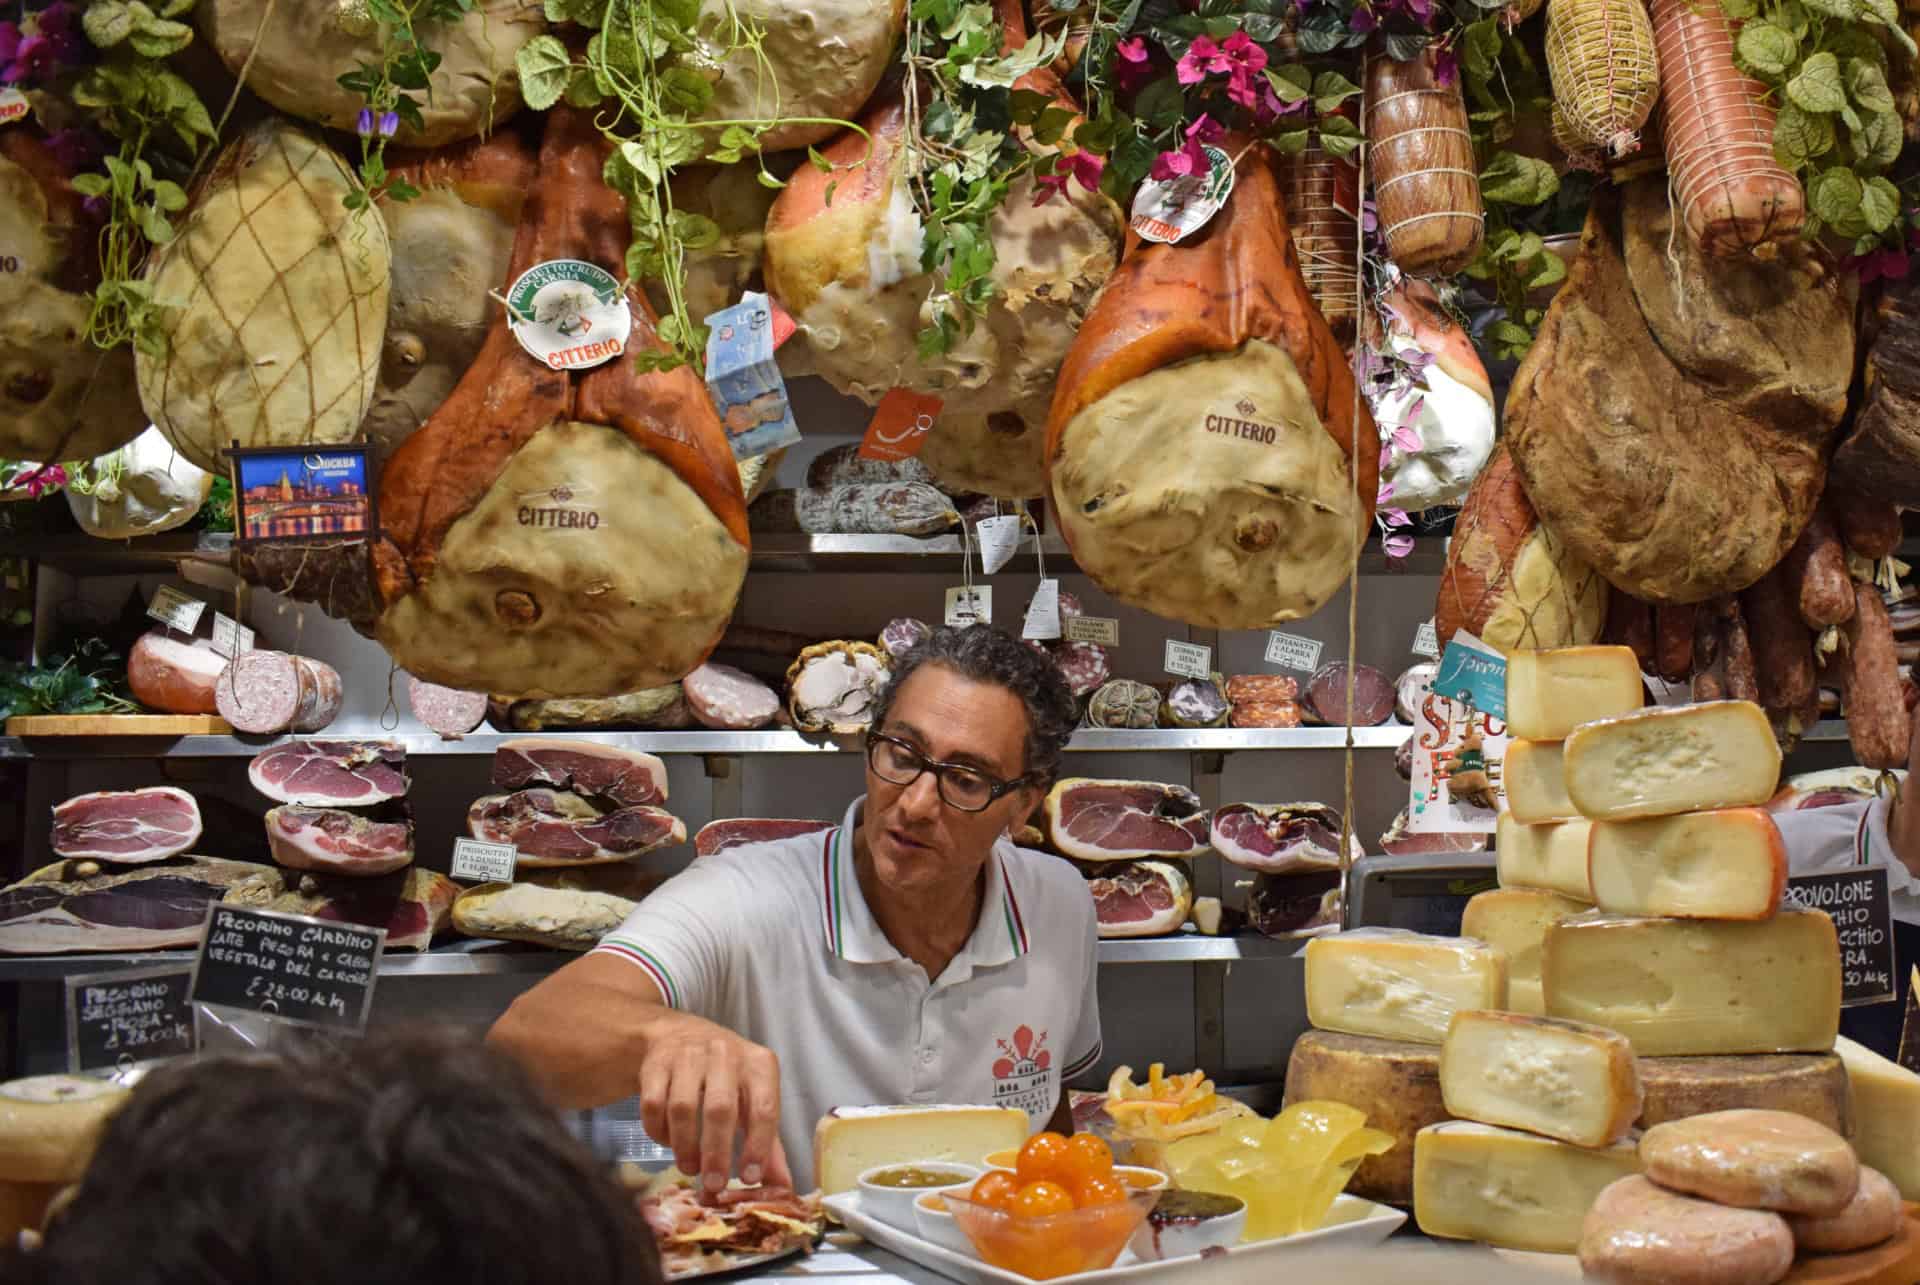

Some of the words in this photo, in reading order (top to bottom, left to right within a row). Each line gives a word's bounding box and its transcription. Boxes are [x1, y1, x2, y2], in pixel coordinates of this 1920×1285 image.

[1132, 214, 1183, 241] CITTERIO
[511, 263, 567, 303] PROSCIUTTO
[569, 264, 609, 284] CRUDO
[534, 271, 579, 289] CARNIA
[548, 338, 621, 368] CITTERIO
[1206, 414, 1276, 445] CITTERIO
[518, 505, 599, 530] CITTERIO
[1783, 879, 1873, 907] PROVOLONE
